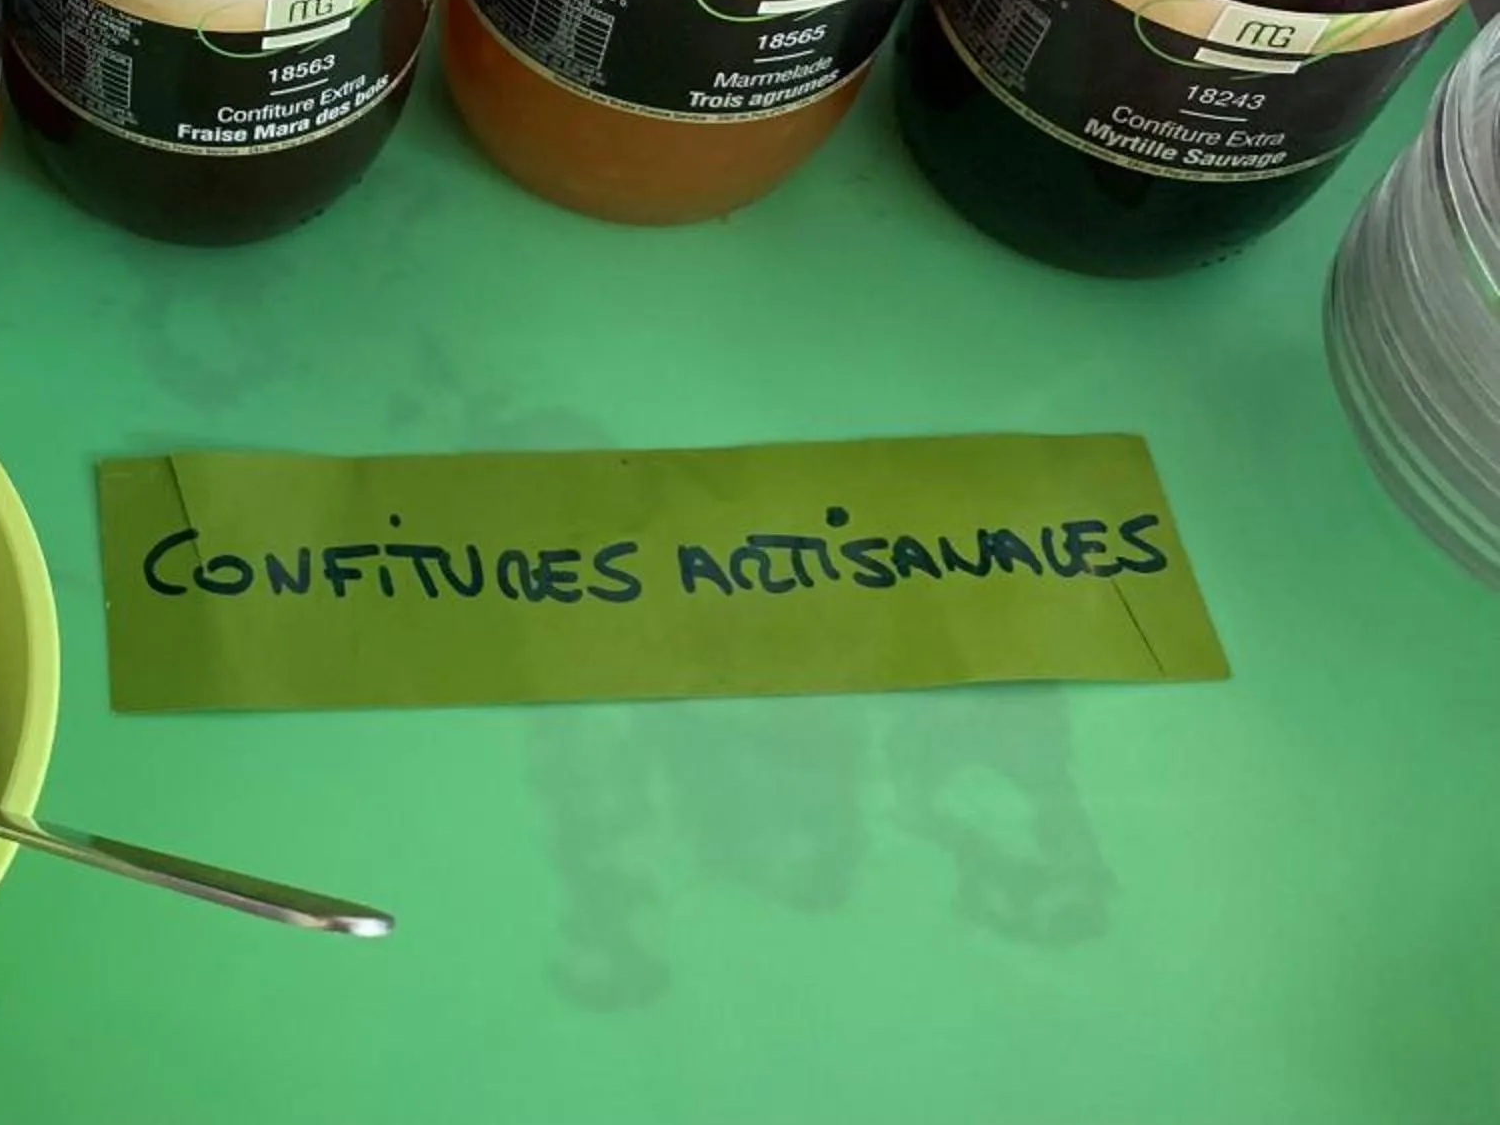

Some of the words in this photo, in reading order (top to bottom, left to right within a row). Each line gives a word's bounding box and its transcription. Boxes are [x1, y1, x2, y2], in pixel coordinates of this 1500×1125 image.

[755, 24, 830, 52] 18565
[267, 53, 336, 84] 18563
[688, 90, 744, 111] Trois
[747, 68, 841, 108] agrumes
[712, 53, 835, 90] Marmelade
[176, 123, 249, 144] Fraise
[253, 116, 312, 143] Mara
[314, 100, 352, 127] des
[353, 73, 390, 111] bois
[216, 96, 316, 125] Confiture
[318, 74, 368, 106] Extra
[1184, 82, 1268, 111] 18243
[1082, 117, 1180, 164] Myrtille
[1182, 147, 1288, 170] Sauvage
[1109, 104, 1222, 146] Confiture
[1225, 128, 1286, 148] Extra
